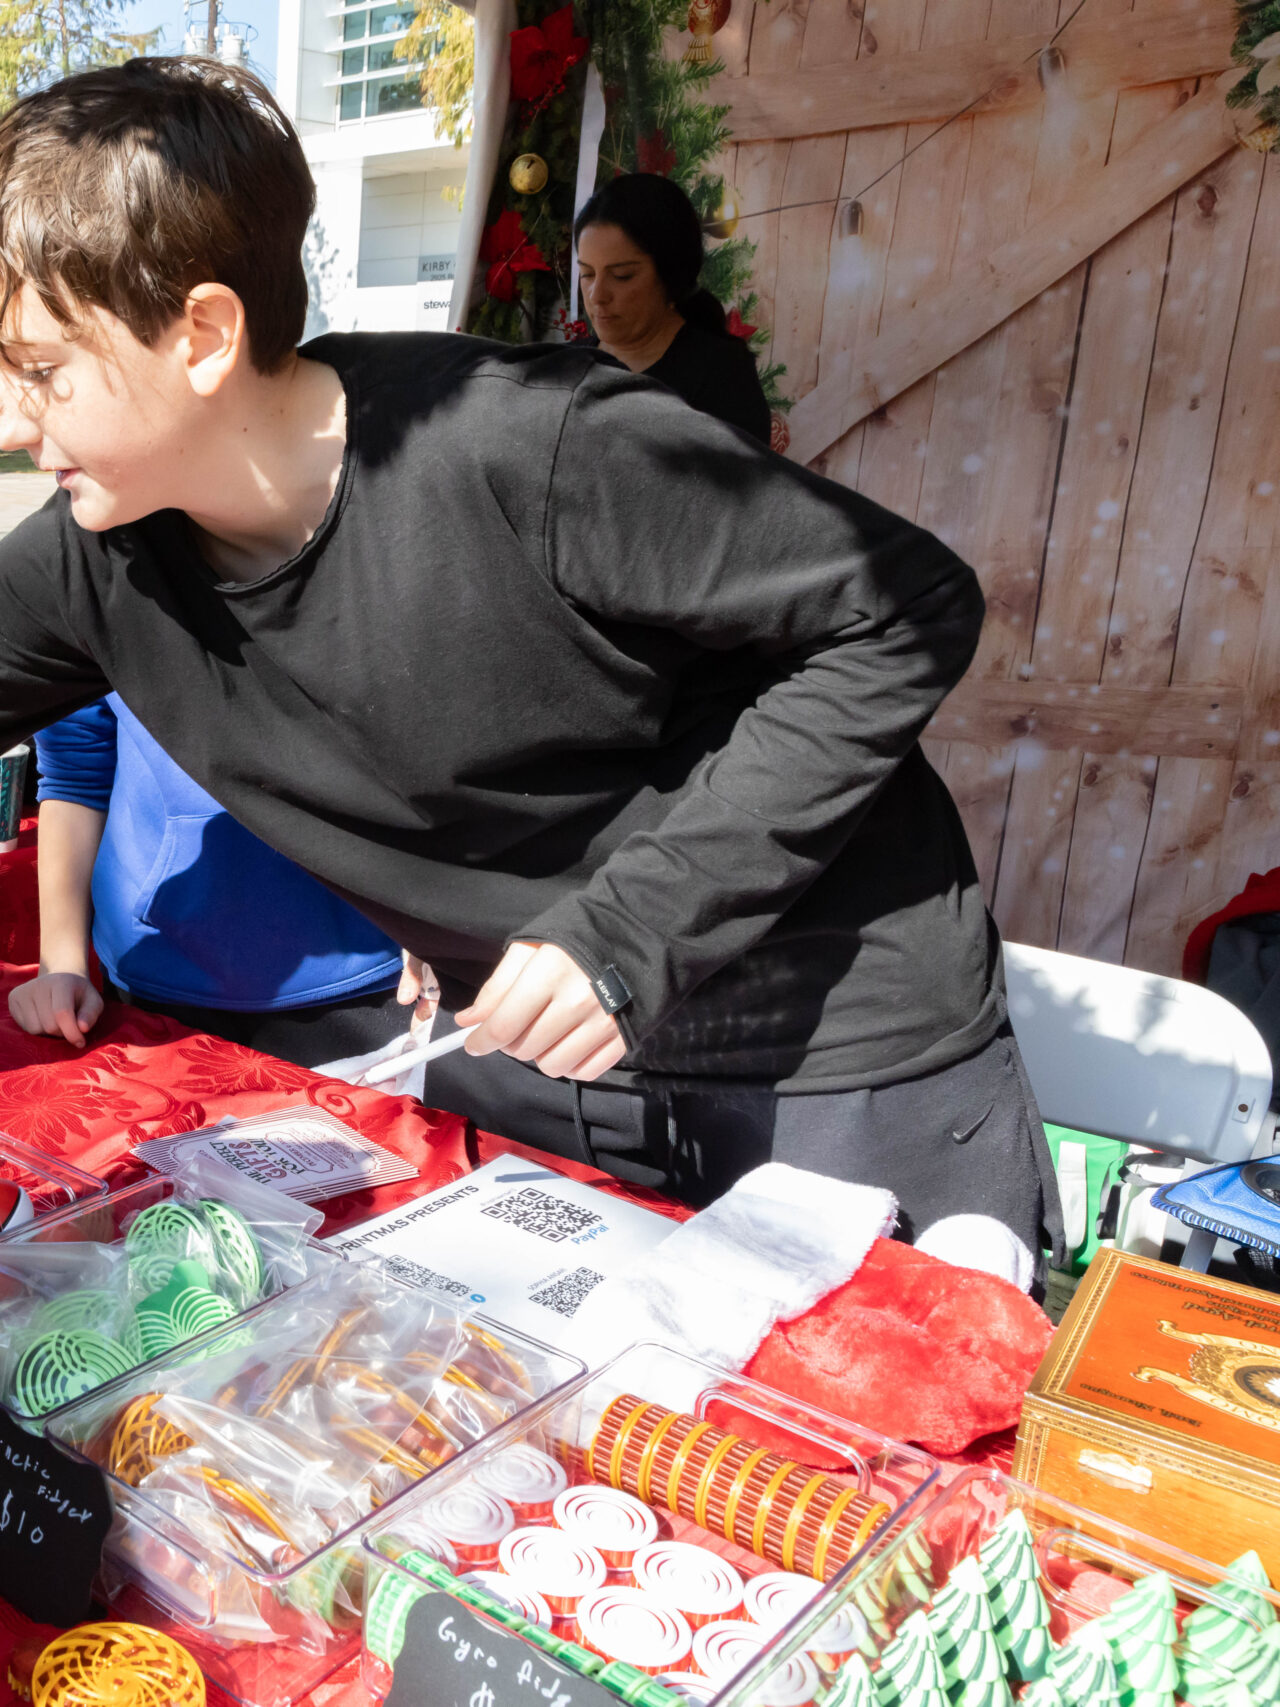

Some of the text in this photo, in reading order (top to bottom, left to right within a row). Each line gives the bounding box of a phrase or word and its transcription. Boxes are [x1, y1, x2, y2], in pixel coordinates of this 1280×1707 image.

[422, 260, 451, 273] KIRBY
[596, 979, 618, 1008] REPLAY
[209, 1141, 250, 1171] PERFECT
[228, 1141, 287, 1180] GIFTS
[273, 1157, 306, 1176] FOR
[243, 1166, 272, 1186] THE
[407, 1185, 479, 1223] PRESENTS
[570, 1223, 610, 1246] PayPal
[37, 1485, 93, 1524] Fidget
[438, 1616, 498, 1669] Gyro
